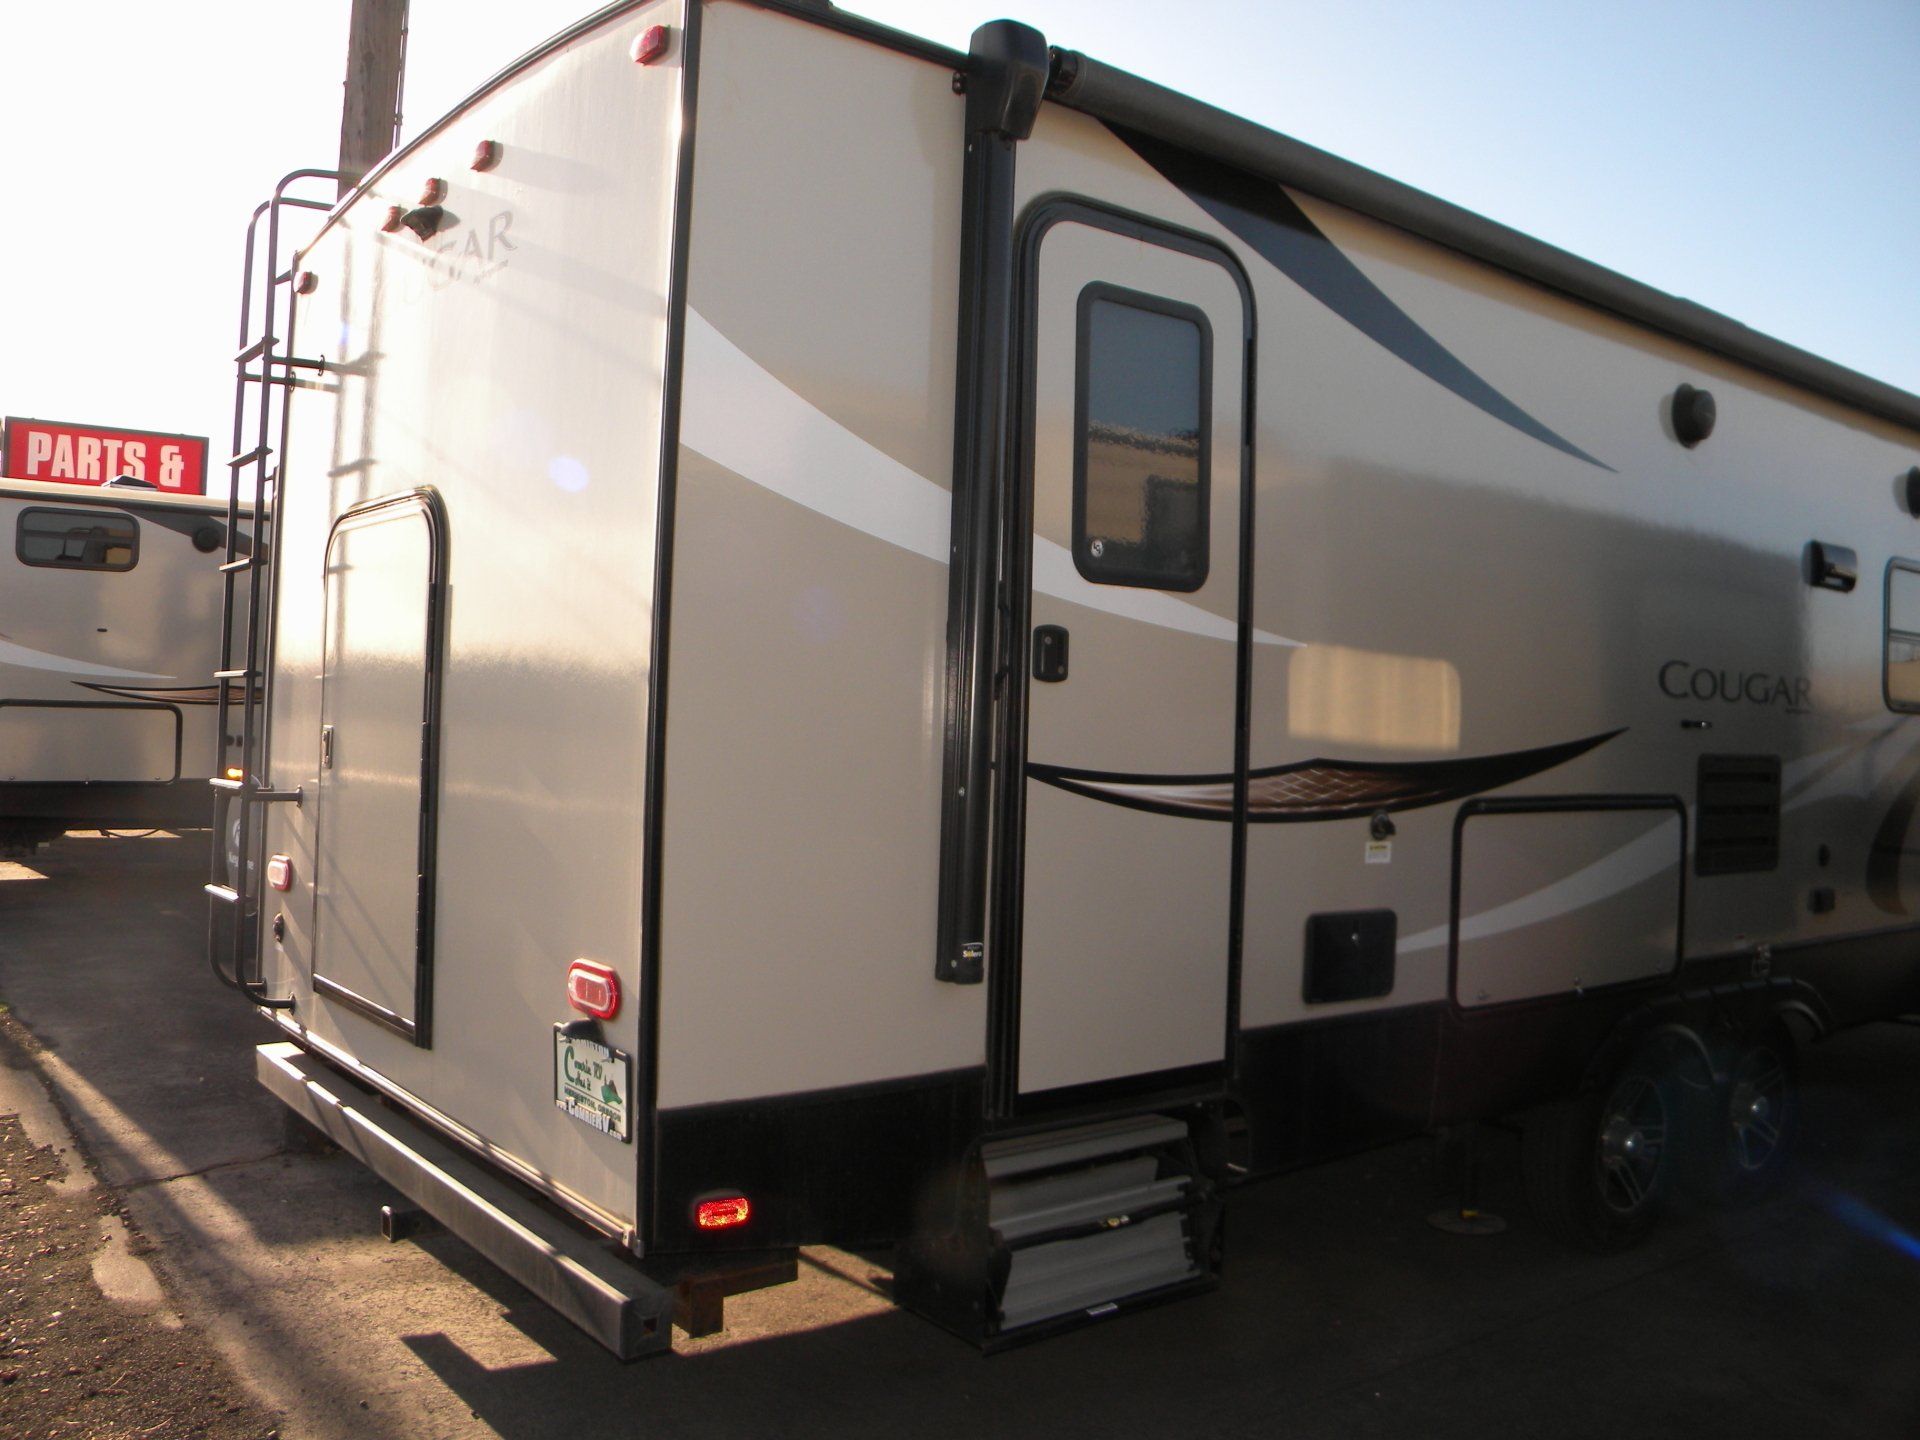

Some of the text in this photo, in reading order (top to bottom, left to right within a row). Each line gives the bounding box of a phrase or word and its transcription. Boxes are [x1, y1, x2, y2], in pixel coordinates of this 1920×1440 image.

[27, 431, 184, 488] PARTS &
[1658, 660, 1812, 706] COUGAR
